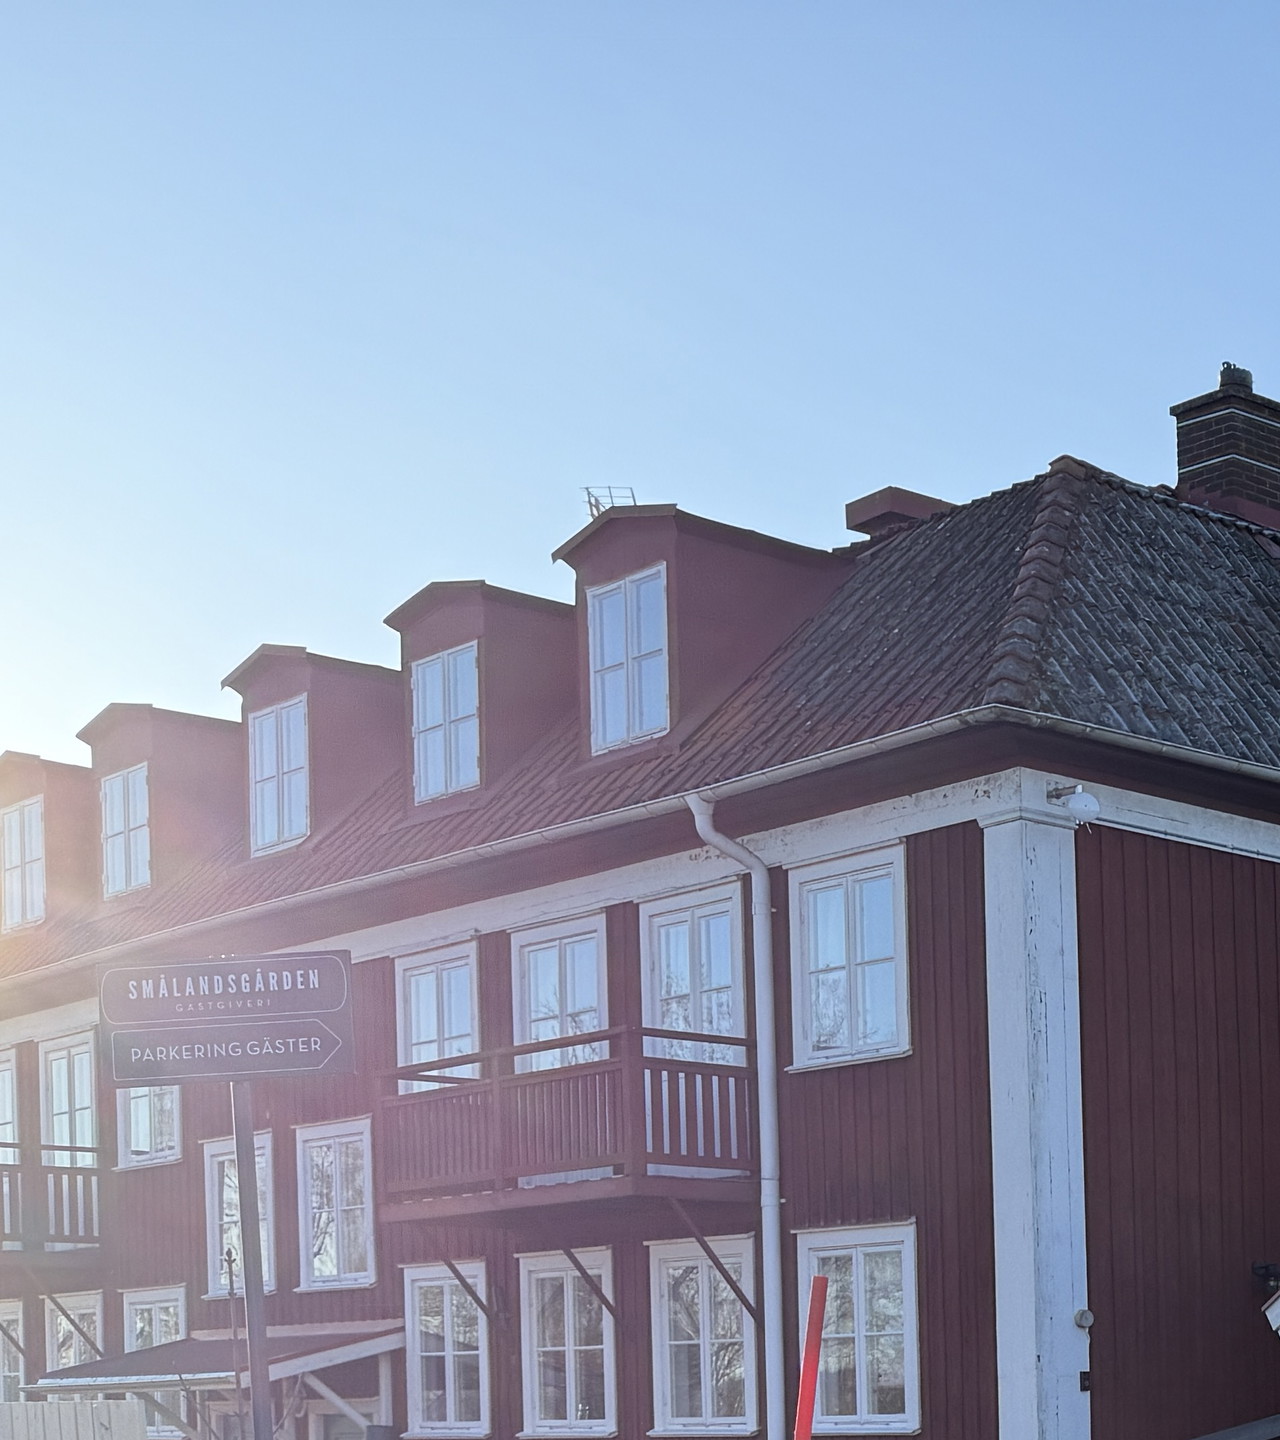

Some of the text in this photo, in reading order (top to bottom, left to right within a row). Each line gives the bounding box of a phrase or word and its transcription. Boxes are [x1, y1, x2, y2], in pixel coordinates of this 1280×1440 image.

[128, 968, 320, 1000] SMÅLANDSGÅRDEN
[175, 998, 272, 1013] GASTGIVERI
[130, 1036, 321, 1063] PARKERING GÄSTER
